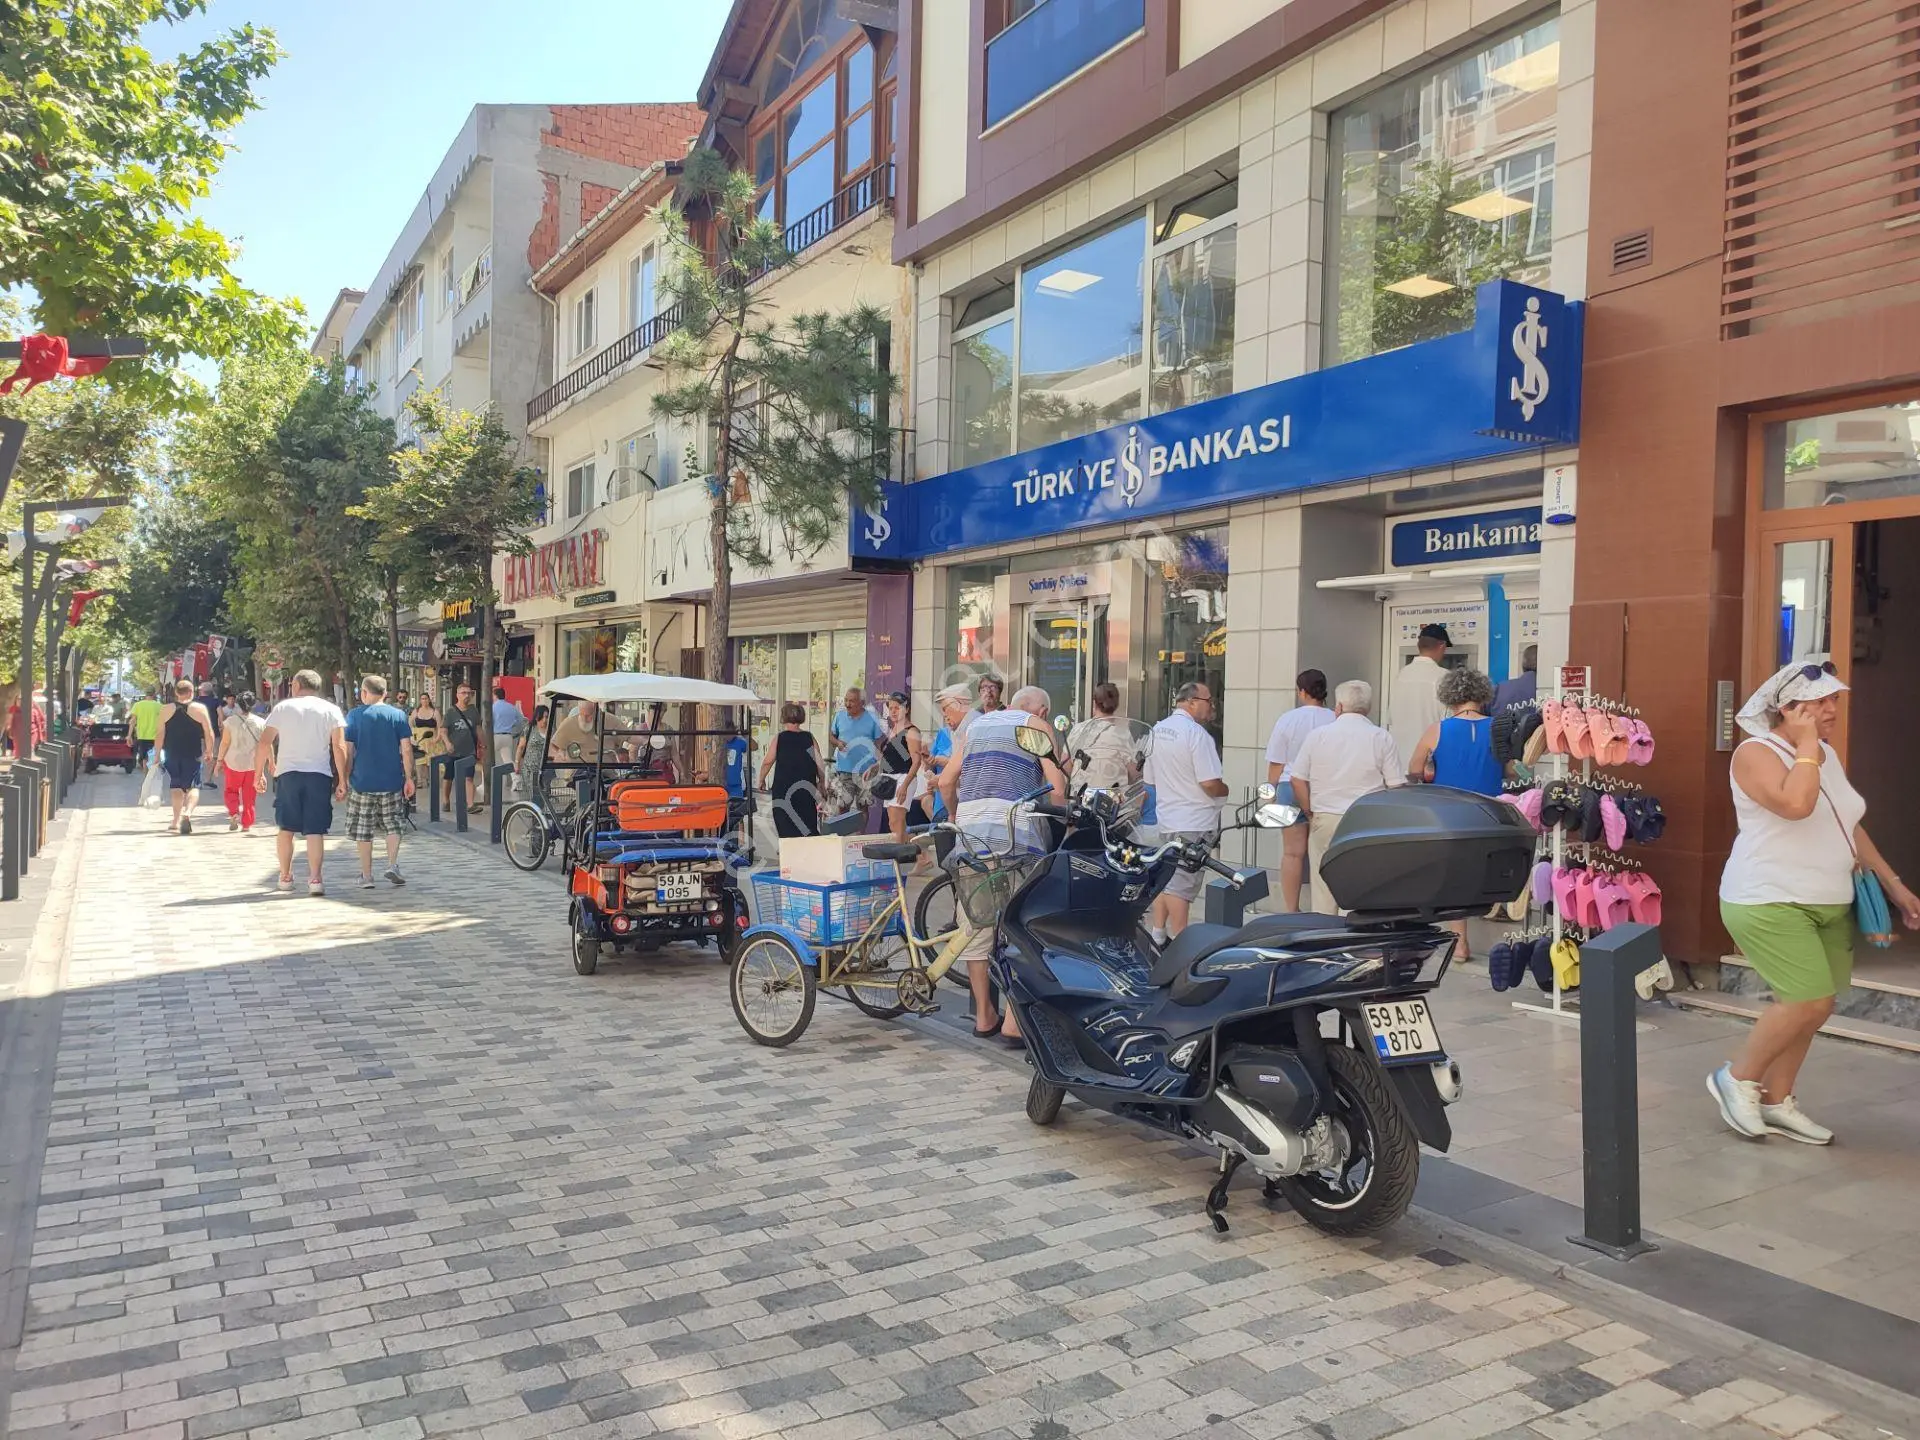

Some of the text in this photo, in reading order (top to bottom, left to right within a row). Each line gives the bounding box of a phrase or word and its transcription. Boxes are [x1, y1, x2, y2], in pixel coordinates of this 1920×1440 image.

[1149, 414, 1291, 477] BANKASI
[1028, 577, 1059, 594] Şarköy
[659, 874, 700, 887] 59 AJN
[667, 887, 689, 899] 095
[1207, 962, 1258, 973] PCX
[1368, 1004, 1425, 1028] 59 AJP
[1389, 1029, 1422, 1052] 870
[1124, 1053, 1153, 1066] PCX
